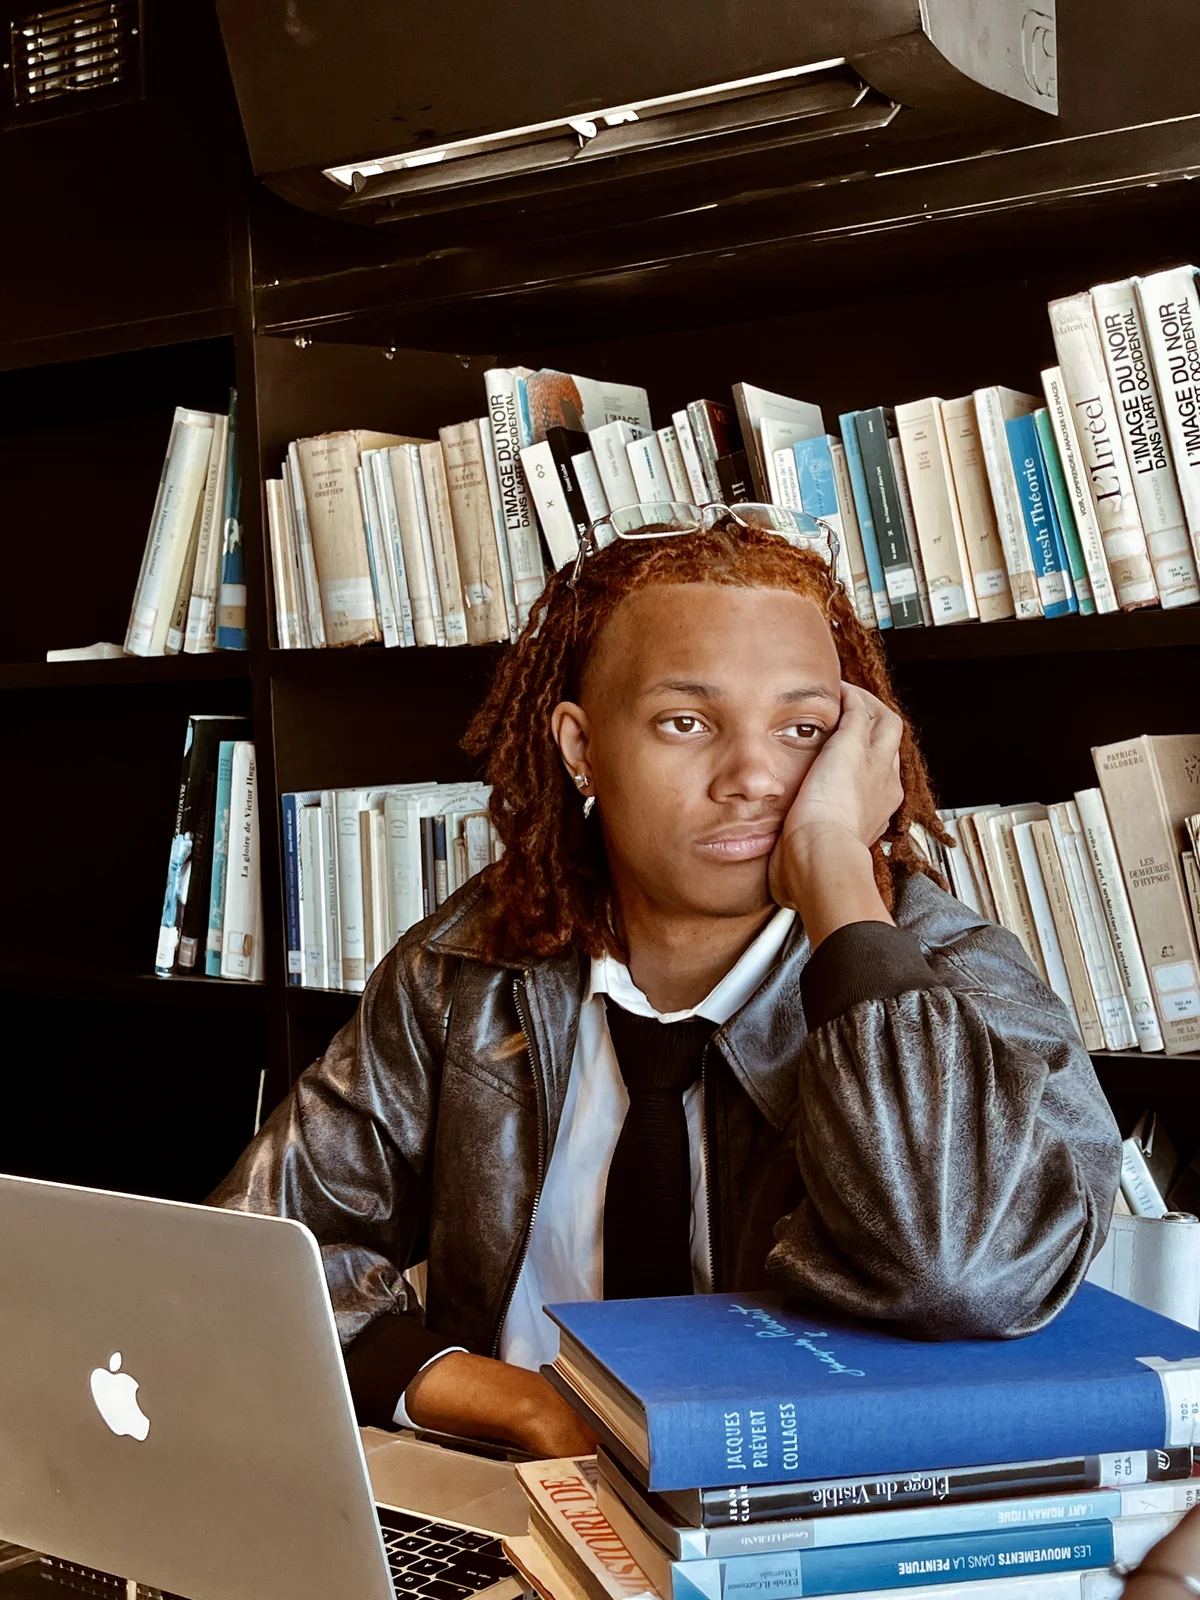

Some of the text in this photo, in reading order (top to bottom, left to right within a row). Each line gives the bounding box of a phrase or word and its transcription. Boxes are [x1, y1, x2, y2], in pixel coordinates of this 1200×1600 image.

[1159, 302, 1182, 351] NOIR
[1178, 297, 1200, 381] OCCIDENTAL
[1168, 356, 1189, 384] DU
[1051, 381, 1061, 405] IMAGES
[1105, 313, 1154, 474] L'IMAGE DU NOIR
[1123, 308, 1167, 469] DANS L'ART OCCIDENTAL
[505, 392, 520, 461] OCCIDENTAL
[1060, 419, 1071, 450] ANALYSER
[490, 394, 521, 530] L'IMAGE DU NOIR
[1075, 396, 1122, 504] L'Irréel
[319, 480, 338, 490] L'ART
[788, 467, 798, 510] ontemporain
[1023, 458, 1046, 527] Théorie
[520, 497, 530, 527] DANS
[1036, 528, 1056, 576] Fresh
[1102, 756, 1144, 770] WALDBERG
[1106, 748, 1138, 761] PATRICK
[245, 789, 253, 817] Victor
[244, 822, 251, 833] de
[243, 837, 251, 863] gloire
[1006, 852, 1014, 866] L'ART
[1087, 828, 1097, 849] écrits
[1092, 850, 1100, 863] sur
[241, 865, 249, 878] La
[1129, 863, 1170, 879] DEMEURES
[1140, 857, 1155, 867] LES
[1133, 874, 1171, 888] D'HYPNOS
[724, 1411, 746, 1470] JACQUES
[749, 1409, 768, 1469] PRÉVERT
[779, 1403, 799, 1470] COLLAGES
[539, 1476, 595, 1504] DE
[729, 1489, 738, 1521] JEAN
[741, 1485, 750, 1522] CLAIR
[812, 1472, 951, 1508] Éloge du Visible
[998, 1505, 1064, 1524] ROMANTIQUE
[741, 1533, 783, 1545] LEGRAND
[899, 1544, 1092, 1575] LES MOUVEMENTS DANS LA PEINTURE
